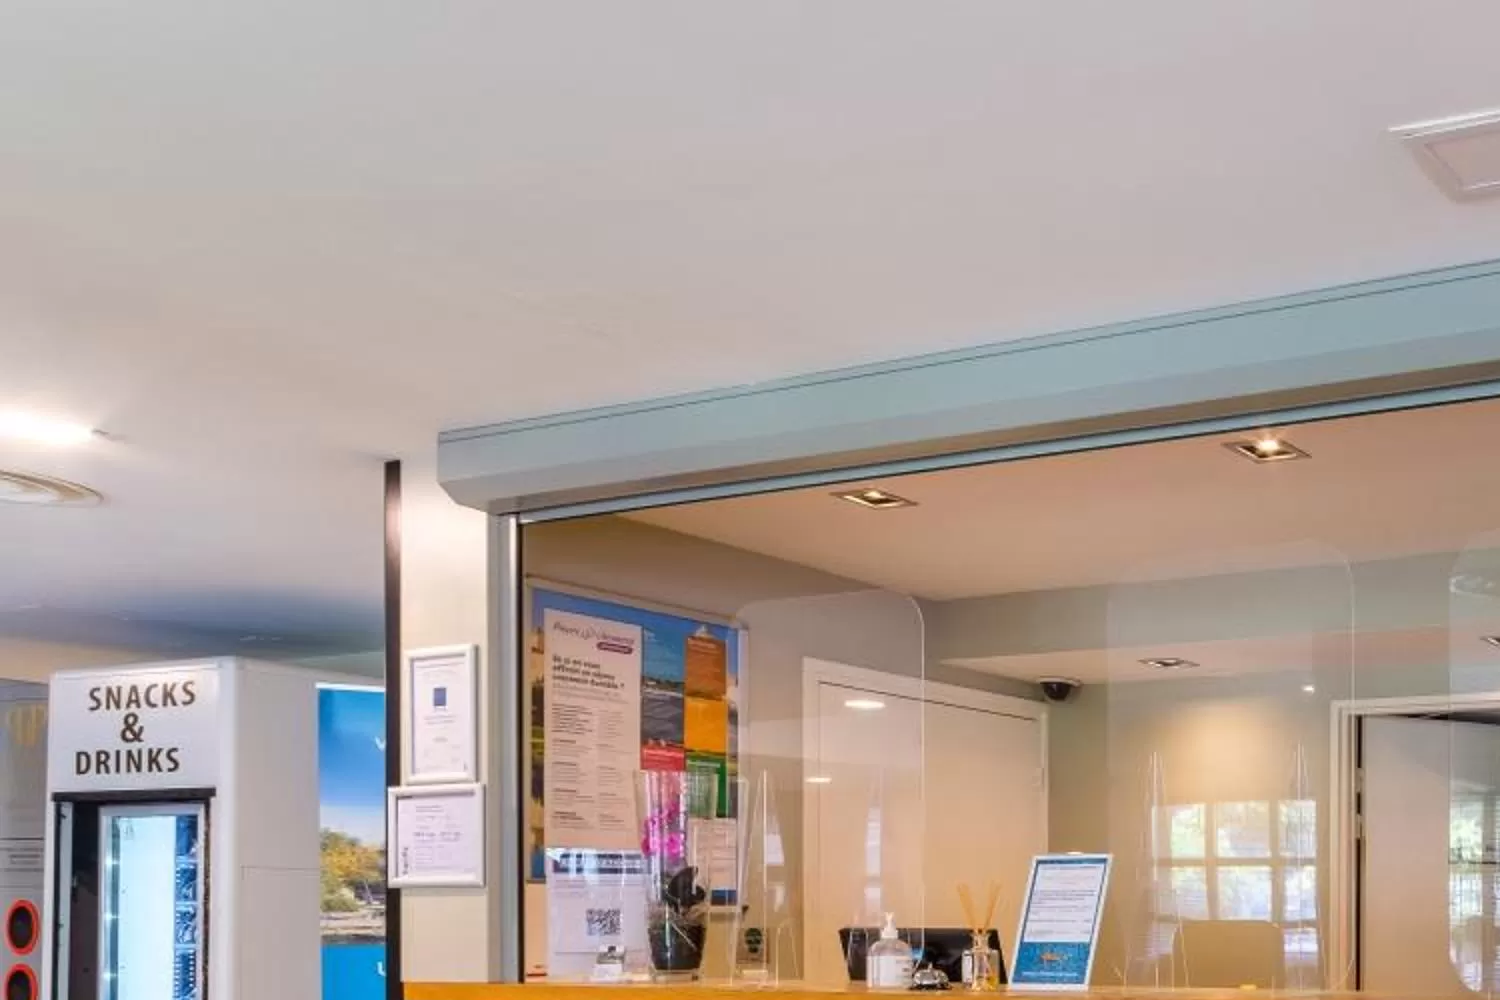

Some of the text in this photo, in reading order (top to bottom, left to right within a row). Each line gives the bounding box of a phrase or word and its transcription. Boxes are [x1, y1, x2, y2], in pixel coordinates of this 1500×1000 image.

[88, 680, 196, 711] SNACKS
[121, 712, 144, 743] &
[75, 747, 180, 775] DRINKS
